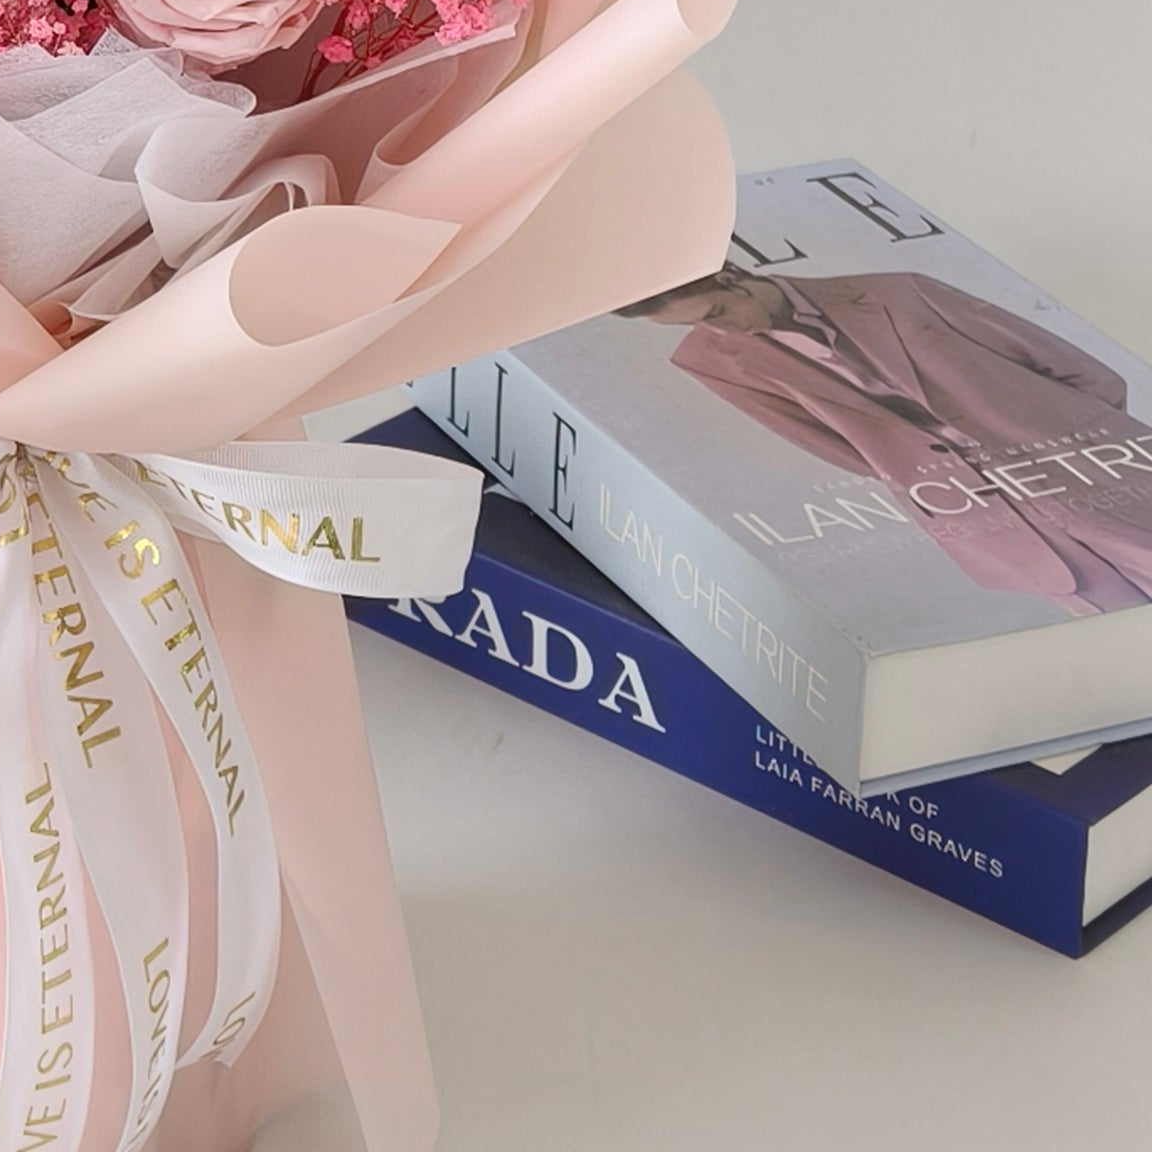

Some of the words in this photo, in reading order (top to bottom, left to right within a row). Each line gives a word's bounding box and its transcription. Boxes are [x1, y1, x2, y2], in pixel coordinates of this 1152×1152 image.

[131, 457, 382, 564] ETERNAL
[406, 361, 577, 532] LLE
[733, 490, 909, 547] ILAN
[908, 432, 1152, 515] CHETRI
[387, 587, 667, 735] RADA
[598, 482, 664, 577] ILAN
[671, 553, 830, 724] CHETRITE
[140, 578, 246, 837] ETERNAL
[754, 750, 804, 788] LAIA
[811, 775, 901, 832] FARRAN
[909, 822, 1004, 879] GRAVES
[908, 796, 940, 821] OF
[24, 761, 75, 1036] ETERNAL
[15, 1097, 68, 1152] VE
[34, 1041, 74, 1092] IS
